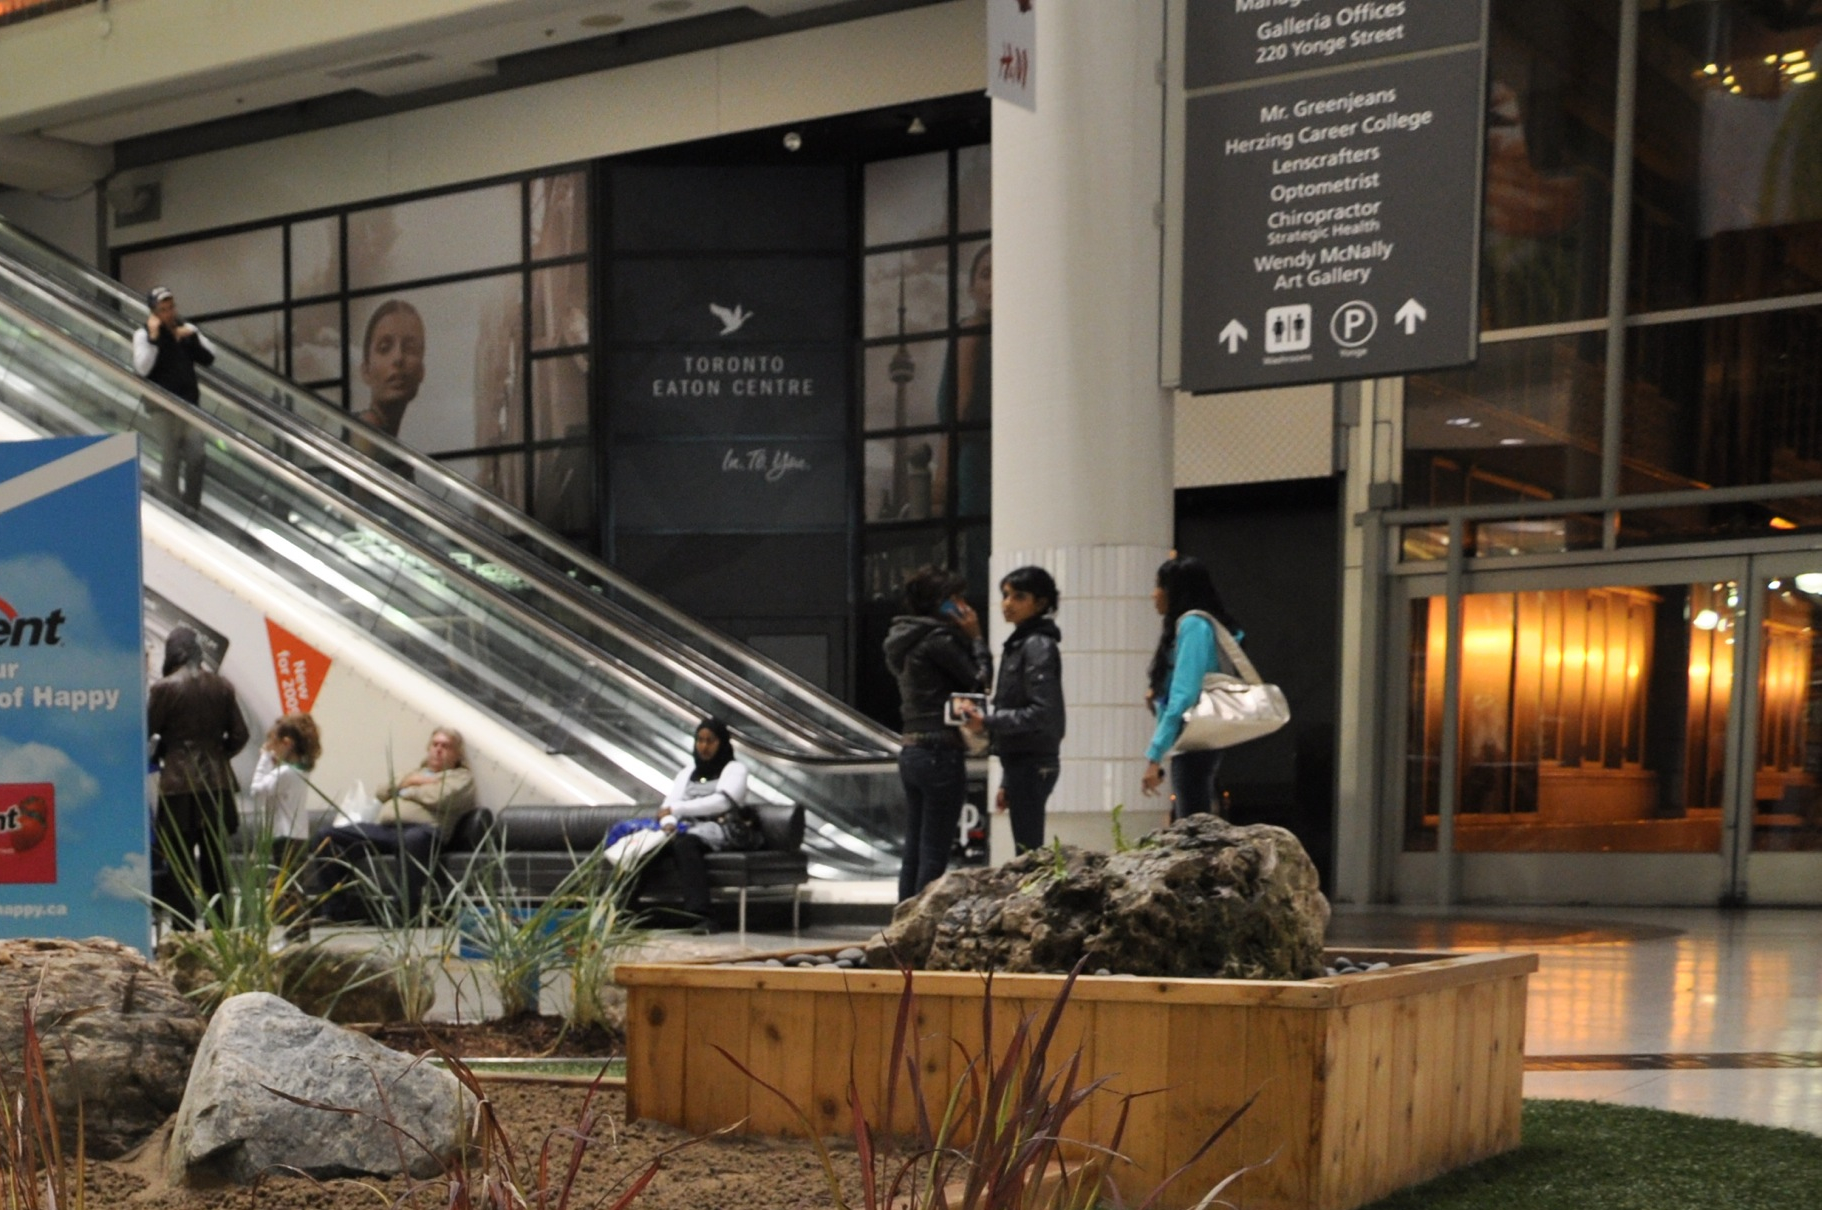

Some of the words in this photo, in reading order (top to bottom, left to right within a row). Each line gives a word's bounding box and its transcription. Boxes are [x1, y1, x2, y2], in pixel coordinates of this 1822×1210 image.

[1257, 13, 1331, 40] Galleria
[1336, 1, 1406, 27] Offices
[1255, 44, 1287, 64] 220
[1292, 38, 1346, 58] Yonge
[1350, 24, 1405, 48] Street
[1260, 107, 1289, 123] Mr.
[1293, 86, 1397, 118] Greenjeans
[1225, 131, 1294, 156] Herzing
[1297, 121, 1357, 144] Career
[1362, 109, 1433, 134] College
[1272, 145, 1381, 175] Lenscrafters
[1270, 172, 1380, 203] Optometrist
[1267, 199, 1382, 229] Chiropractor
[1267, 227, 1328, 246] Strategic
[1332, 219, 1381, 239] Health
[1254, 251, 1316, 273] Wendy
[1320, 240, 1395, 263] McNally
[1274, 272, 1303, 292] Art
[1307, 265, 1372, 287] Gallery
[683, 355, 784, 374] TORONTO
[652, 379, 721, 398] EATON
[732, 378, 814, 397] CENTRE
[276, 650, 290, 677] for
[293, 659, 310, 701] New
[33, 684, 120, 712] Happy
